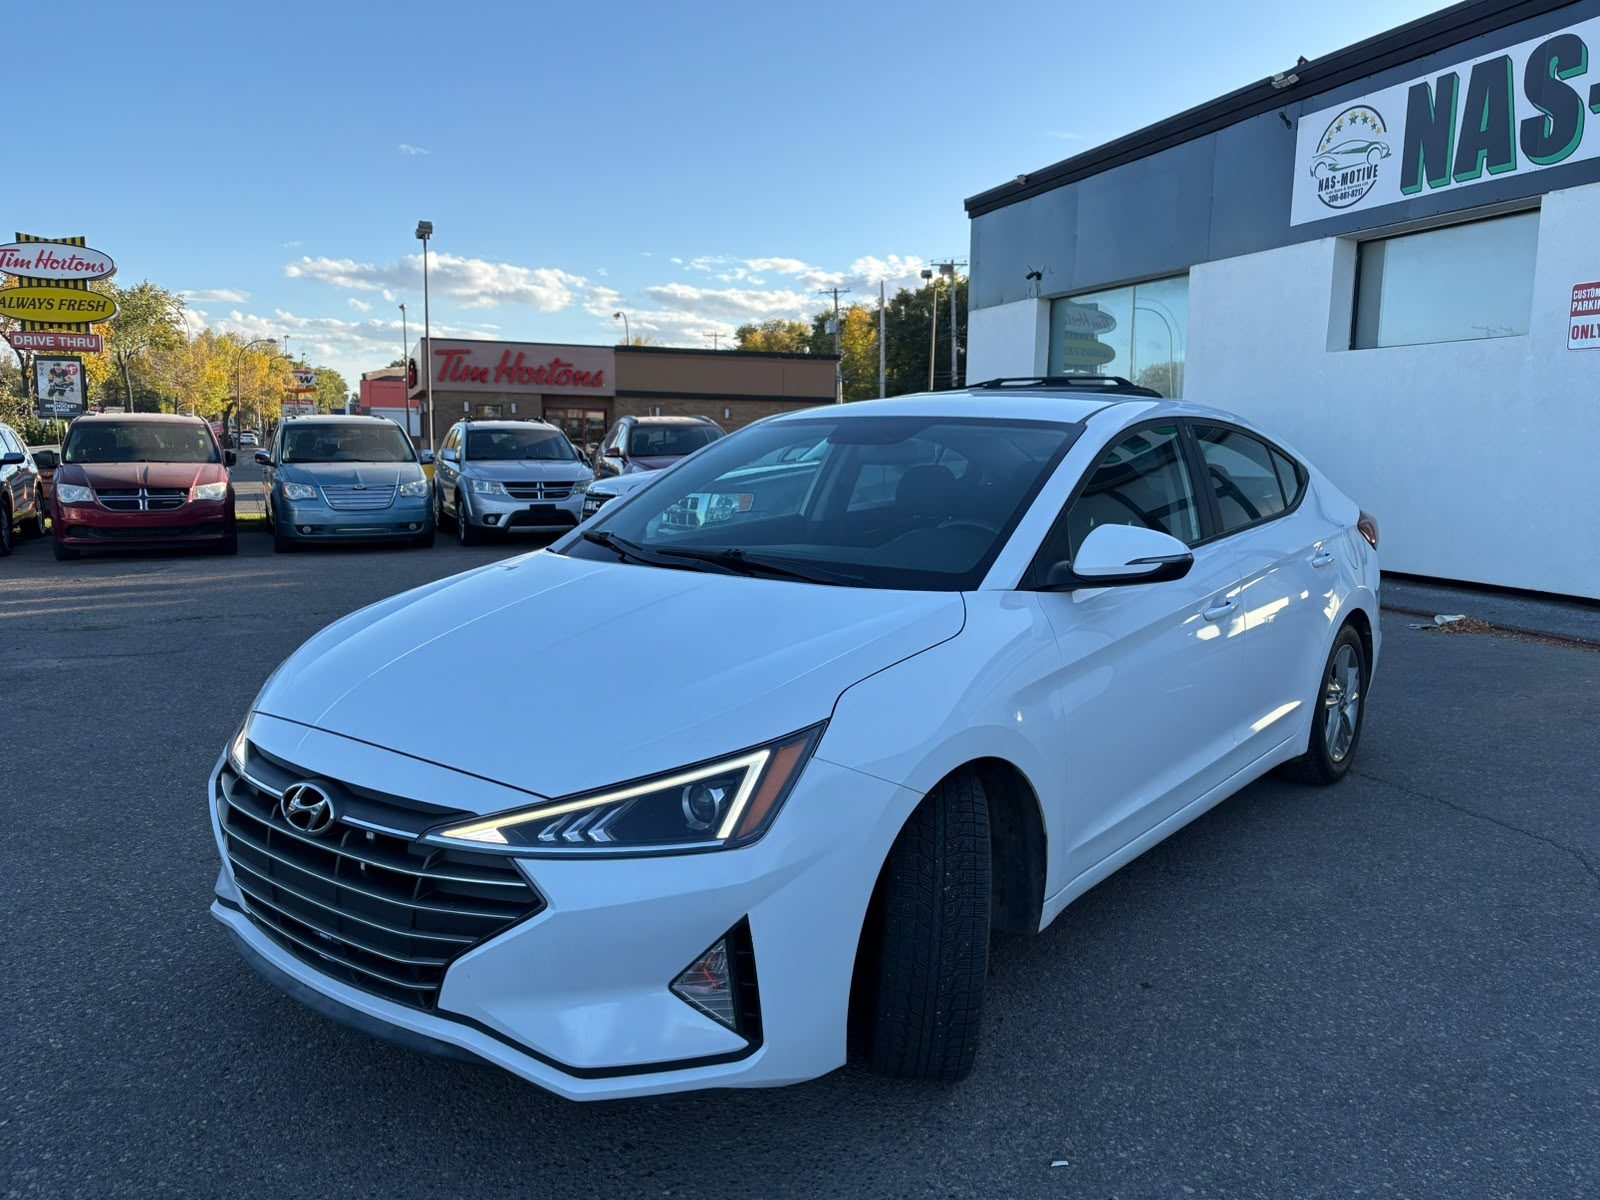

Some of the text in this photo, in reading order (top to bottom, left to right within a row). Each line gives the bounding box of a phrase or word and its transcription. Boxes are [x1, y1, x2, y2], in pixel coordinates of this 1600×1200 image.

[1318, 164, 1378, 192] NAS-MOTIVE
[0, 248, 105, 273] Tim Hortons
[0, 296, 108, 313] ALWAYS FRESH
[13, 334, 97, 349] DRIVE THRU
[434, 349, 605, 388] Tim Hortons
